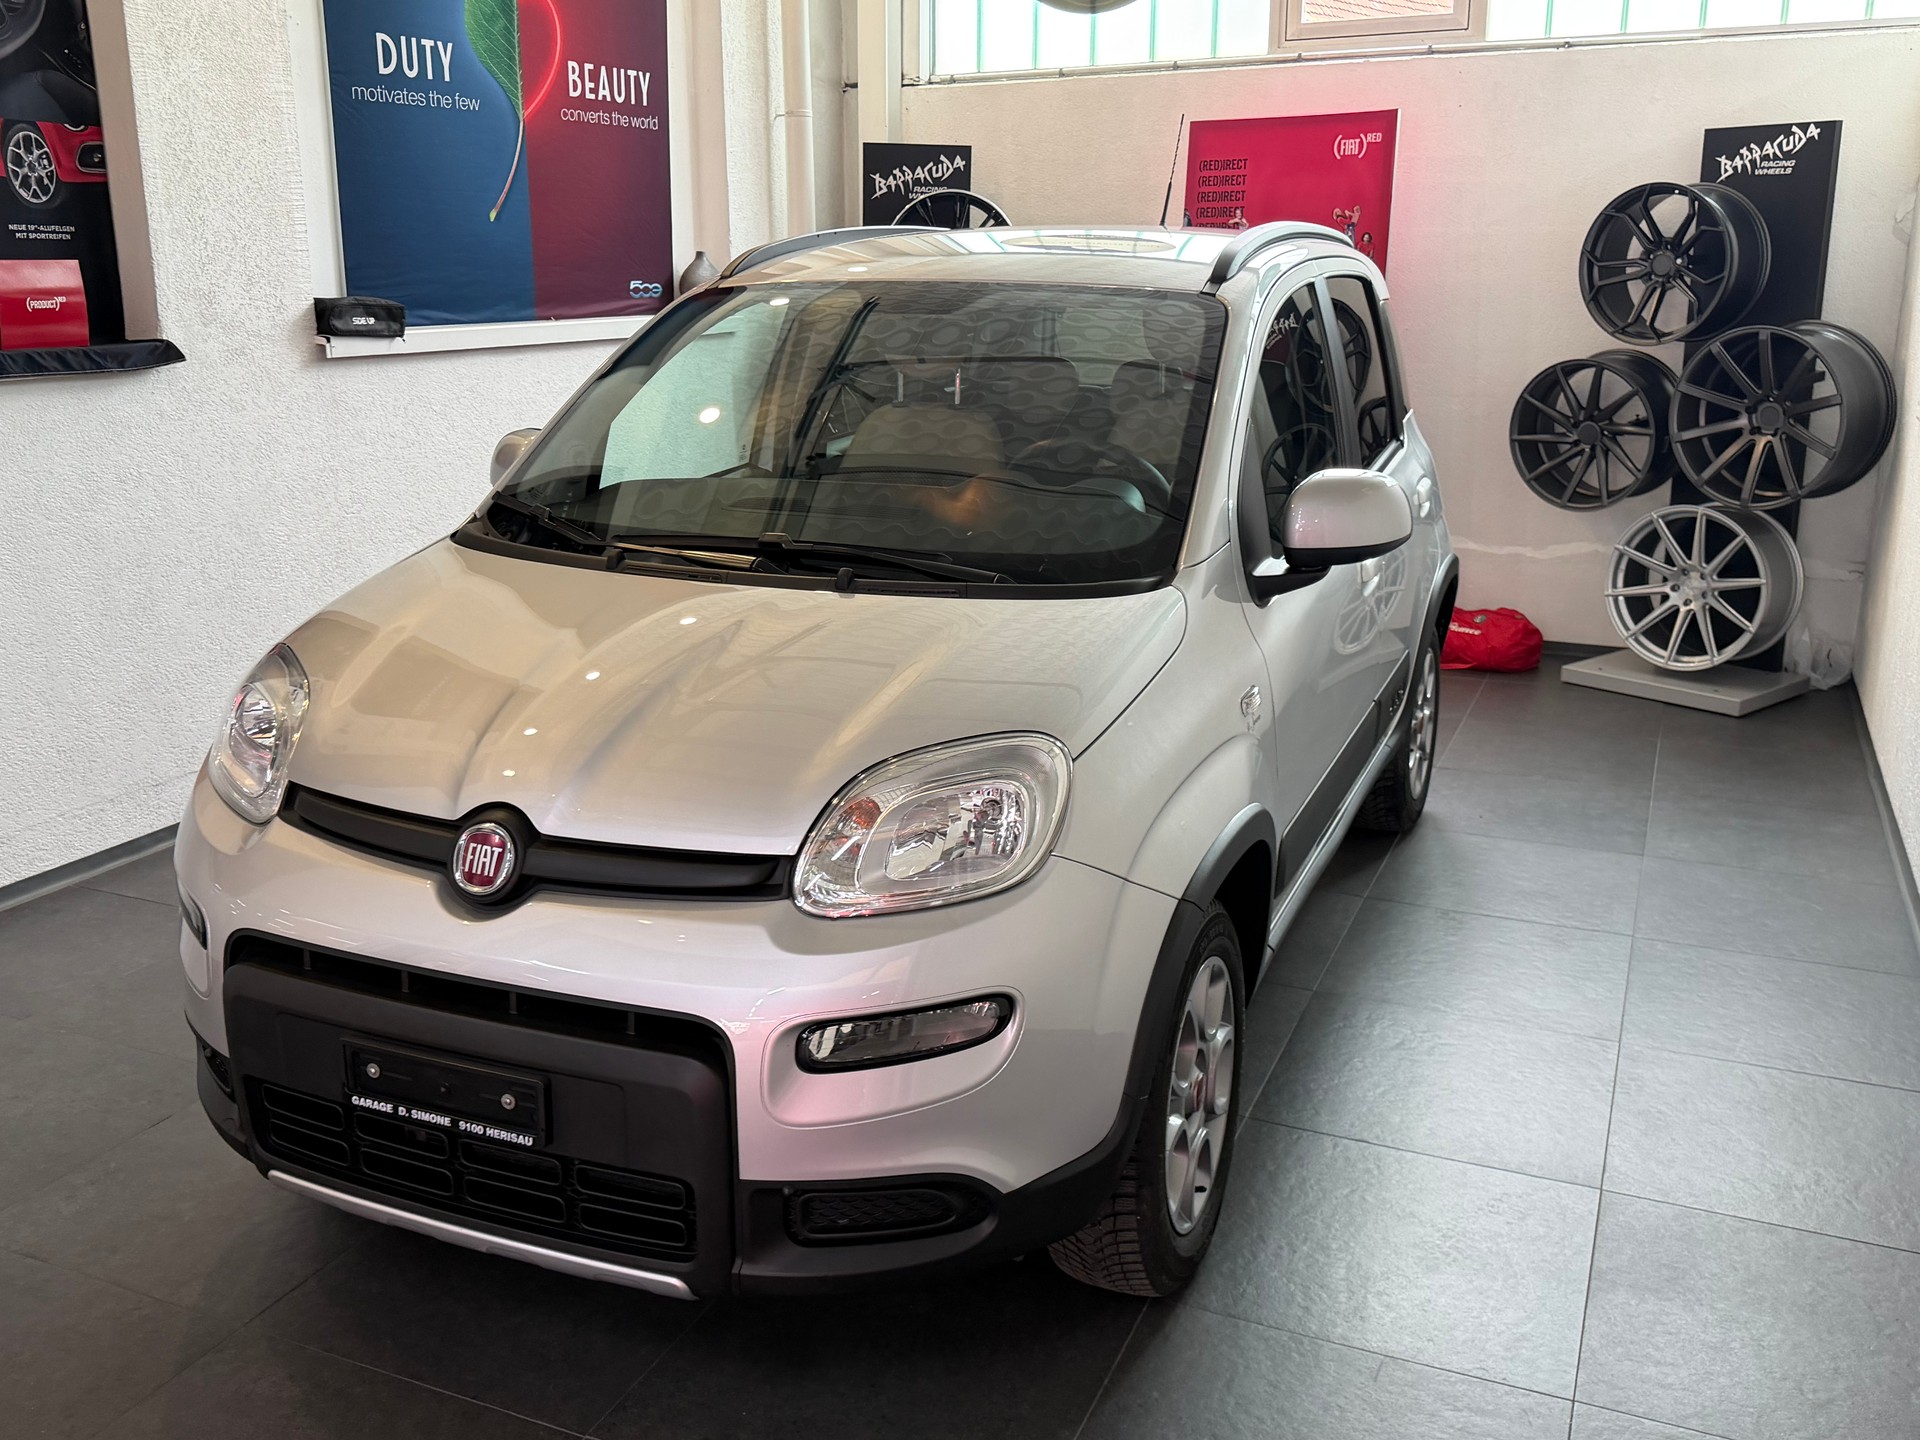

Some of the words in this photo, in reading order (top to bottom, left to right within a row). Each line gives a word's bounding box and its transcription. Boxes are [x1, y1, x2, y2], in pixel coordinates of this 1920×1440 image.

[375, 31, 454, 82] DUTY
[351, 84, 427, 107] motivates
[428, 90, 452, 109] the
[454, 92, 480, 111] few
[567, 60, 651, 107] BEAUTY
[560, 108, 610, 125] converts
[612, 111, 629, 127] the
[630, 115, 659, 130] world
[1199, 158, 1248, 172] (RED)IRECT
[1715, 123, 1821, 184] BARRACUDA
[1760, 159, 1797, 168] RACING
[869, 154, 966, 200] BARRACUDA
[1198, 174, 1247, 188] (RED)IRECT
[1197, 190, 1246, 204] (RED)IRECT
[464, 842, 503, 877] FIAT
[351, 1095, 394, 1113] GARAGE
[398, 1106, 410, 1117] D.
[410, 1109, 452, 1127] SIMONE
[458, 1120, 484, 1135] 9100
[485, 1126, 534, 1146] HERISAU
